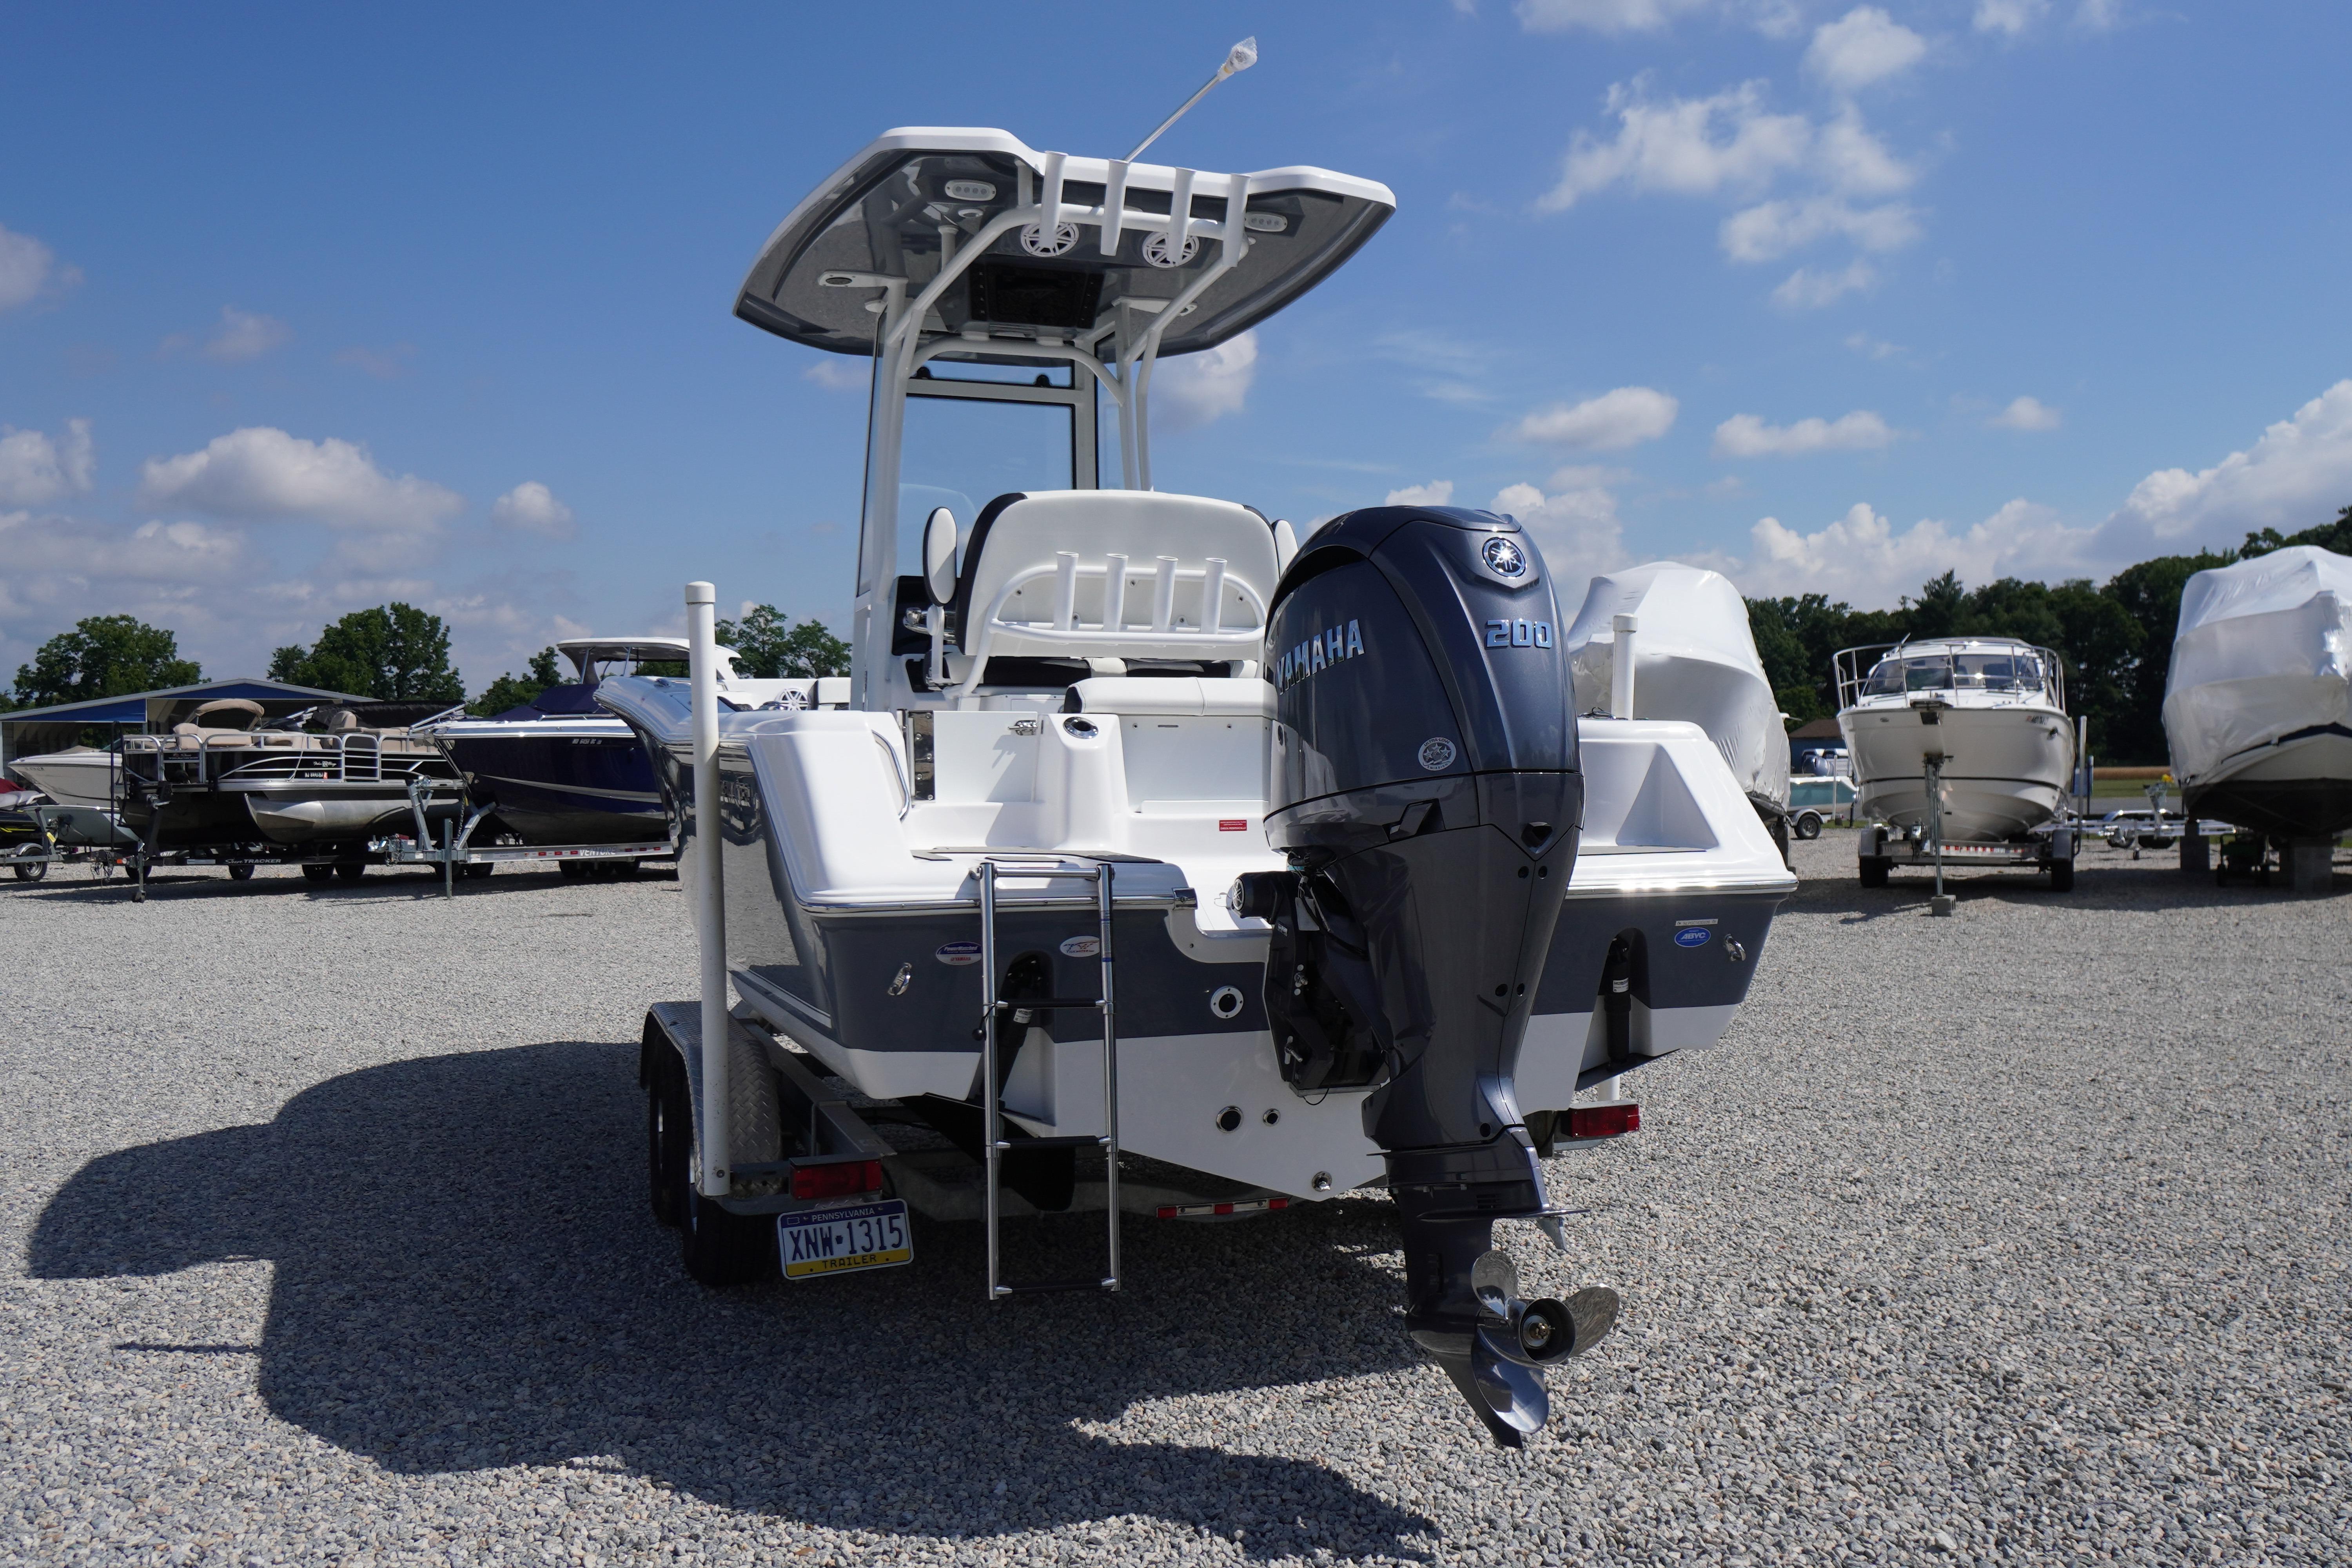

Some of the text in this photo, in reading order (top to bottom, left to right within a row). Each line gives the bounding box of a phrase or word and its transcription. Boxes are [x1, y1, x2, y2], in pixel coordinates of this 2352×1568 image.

[1486, 619, 1552, 648] 200
[1276, 619, 1365, 695] YAMAHA
[579, 846, 617, 857] VENTURE
[1681, 932, 1706, 940] ABYC
[812, 1207, 875, 1222] PENNSYLVANIA
[821, 1254, 877, 1269] TRAILER
